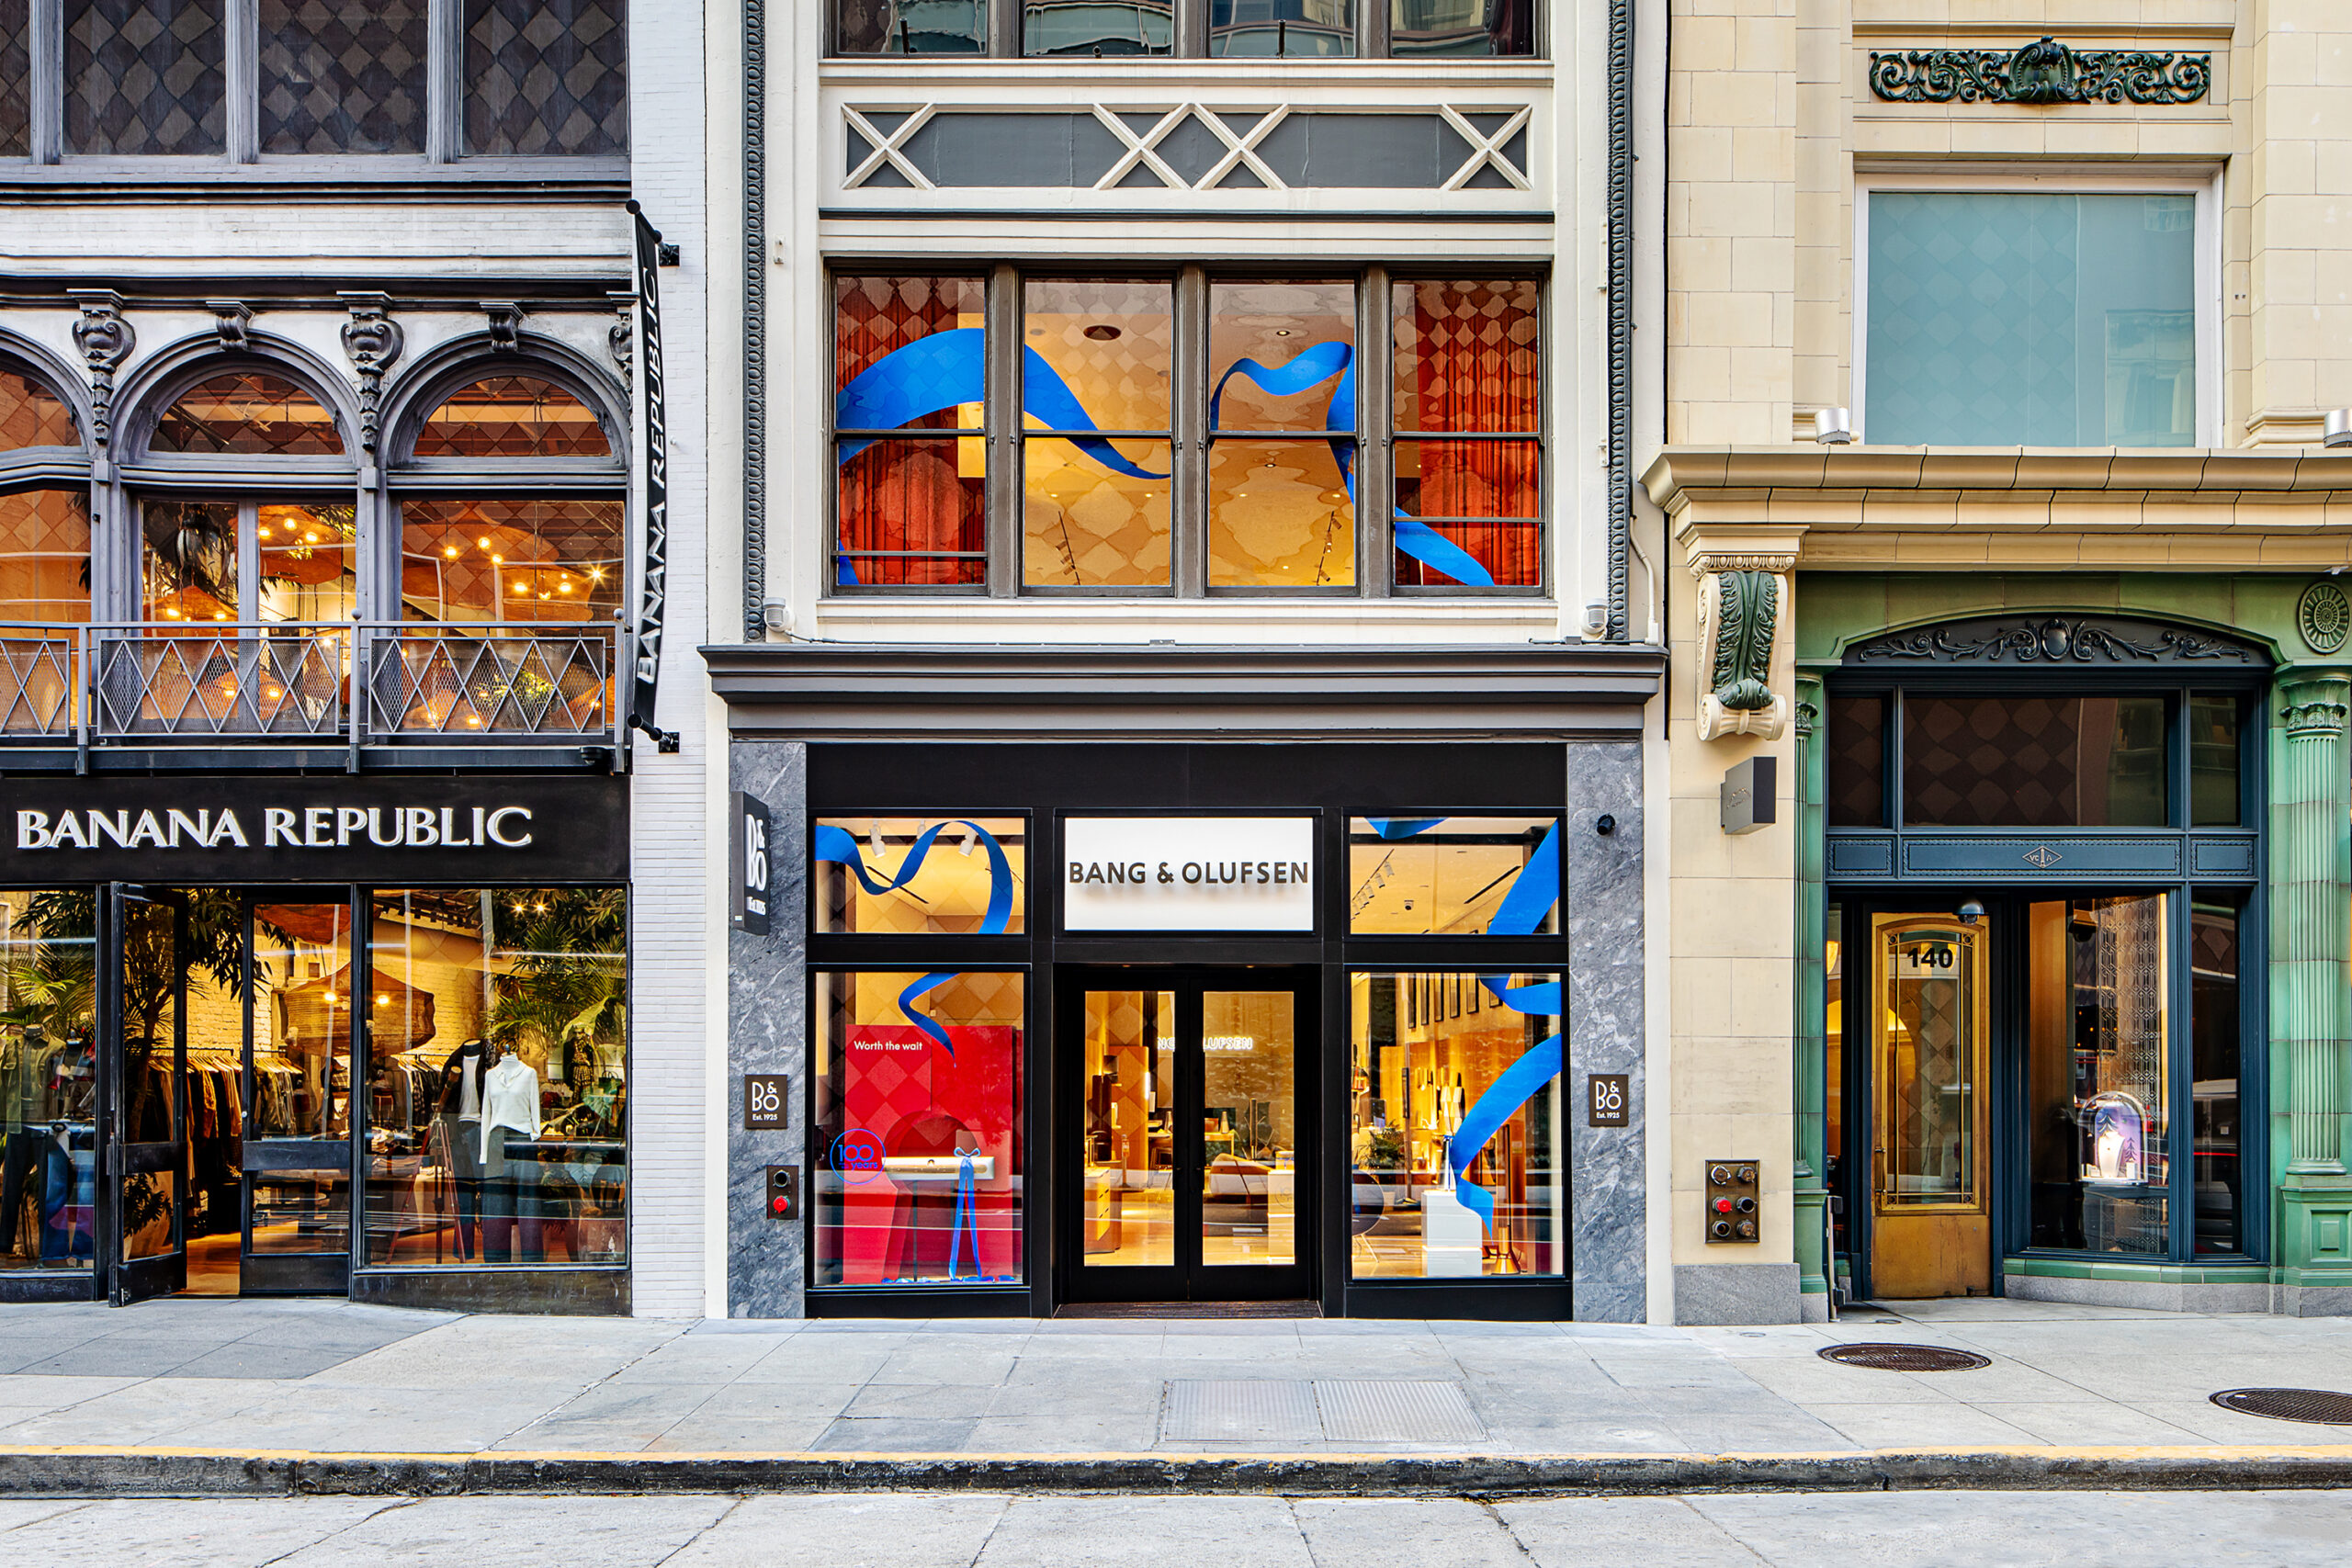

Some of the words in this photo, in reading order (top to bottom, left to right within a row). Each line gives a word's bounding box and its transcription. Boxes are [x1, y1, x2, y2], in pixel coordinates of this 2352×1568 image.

[643, 266, 665, 490] REPUBLIC
[637, 501, 665, 684] BANANA
[17, 808, 249, 849] BANANA
[265, 807, 533, 848] REPUBLIC
[1069, 862, 1146, 884] BANG
[1157, 862, 1174, 884] &
[1182, 862, 1308, 885] OLUFSEN
[1906, 947, 1954, 969] 140
[854, 1040, 883, 1051] Worth
[885, 1040, 900, 1051] the
[902, 1041, 922, 1051] wait
[1203, 1037, 1253, 1050] LUFSEN
[838, 1145, 875, 1161] 100
[851, 1162, 877, 1172] years
